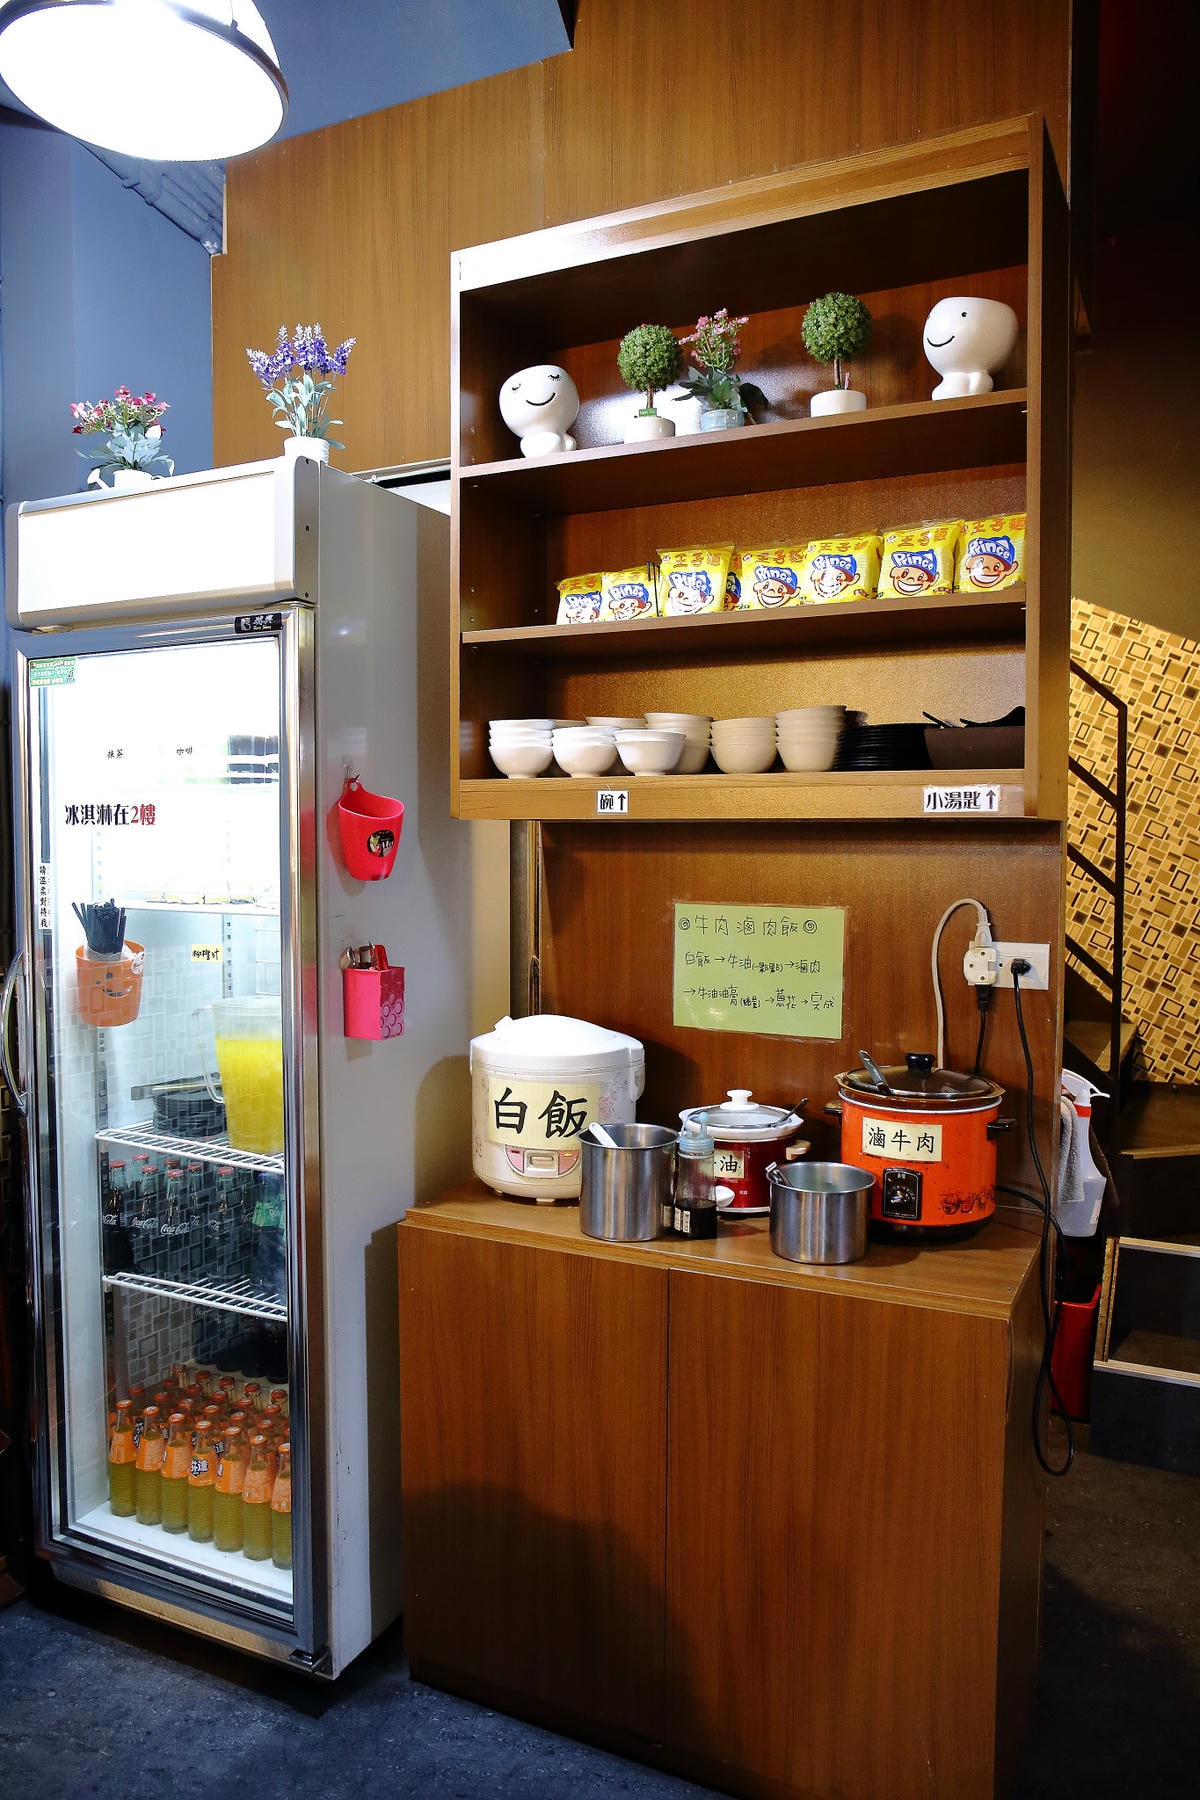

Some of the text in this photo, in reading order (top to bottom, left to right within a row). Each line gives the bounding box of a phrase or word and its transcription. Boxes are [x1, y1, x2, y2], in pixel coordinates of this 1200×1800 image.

[968, 539, 1011, 560] Prince
[812, 554, 853, 571] Prince
[892, 551, 935, 570] Prince
[756, 566, 793, 584] Prince
[600, 793, 614, 810] 碗
[925, 791, 982, 810] 小湯匙
[64, 803, 156, 826] 冰淇淋在2樓
[694, 914, 799, 937] 牛肉滷肉飯
[191, 948, 220, 961] 柳橙汁
[685, 951, 711, 967] 白飯
[810, 991, 835, 1011] 完成
[494, 1087, 588, 1139] 白飯
[868, 1126, 935, 1154] 滷牛肉
[714, 1154, 739, 1173] 油
